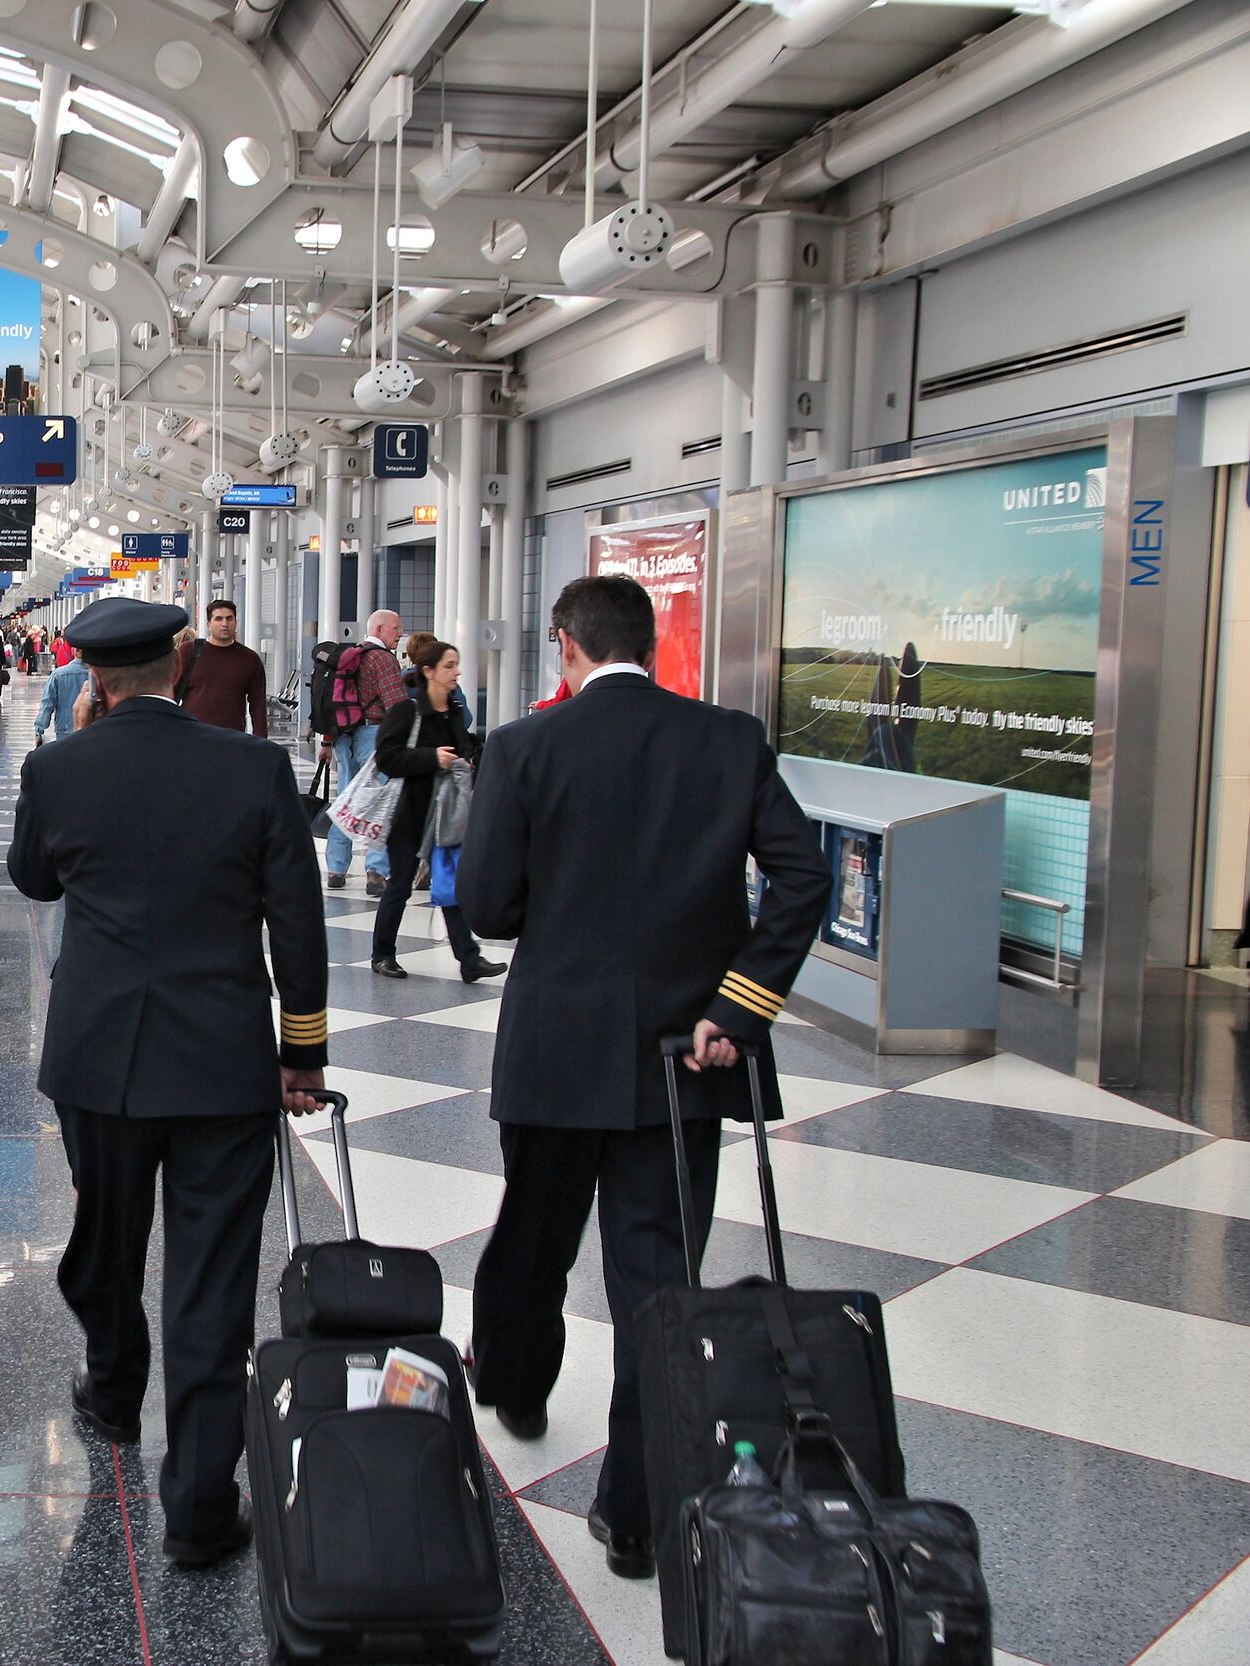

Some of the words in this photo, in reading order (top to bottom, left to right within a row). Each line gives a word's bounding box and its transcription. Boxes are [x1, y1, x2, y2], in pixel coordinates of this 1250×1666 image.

[1003, 480, 1082, 511] UNITED
[223, 517, 246, 527] C20
[1128, 500, 1165, 587] MEN
[87, 568, 104, 577] C18
[639, 556, 649, 577] in
[657, 552, 698, 578] Episodes.
[820, 610, 882, 645] legroom
[941, 606, 1018, 649] friendly
[811, 695, 841, 711] Purchase
[841, 700, 860, 713] more
[860, 699, 890, 717] legroom
[891, 701, 899, 717] in
[900, 702, 937, 723] Economy
[961, 707, 989, 728] today.
[992, 710, 1008, 731] fly
[1007, 711, 1024, 730] the
[1025, 712, 1066, 736] friendly
[1065, 716, 1094, 736] skies
[337, 804, 383, 840] PARIS
